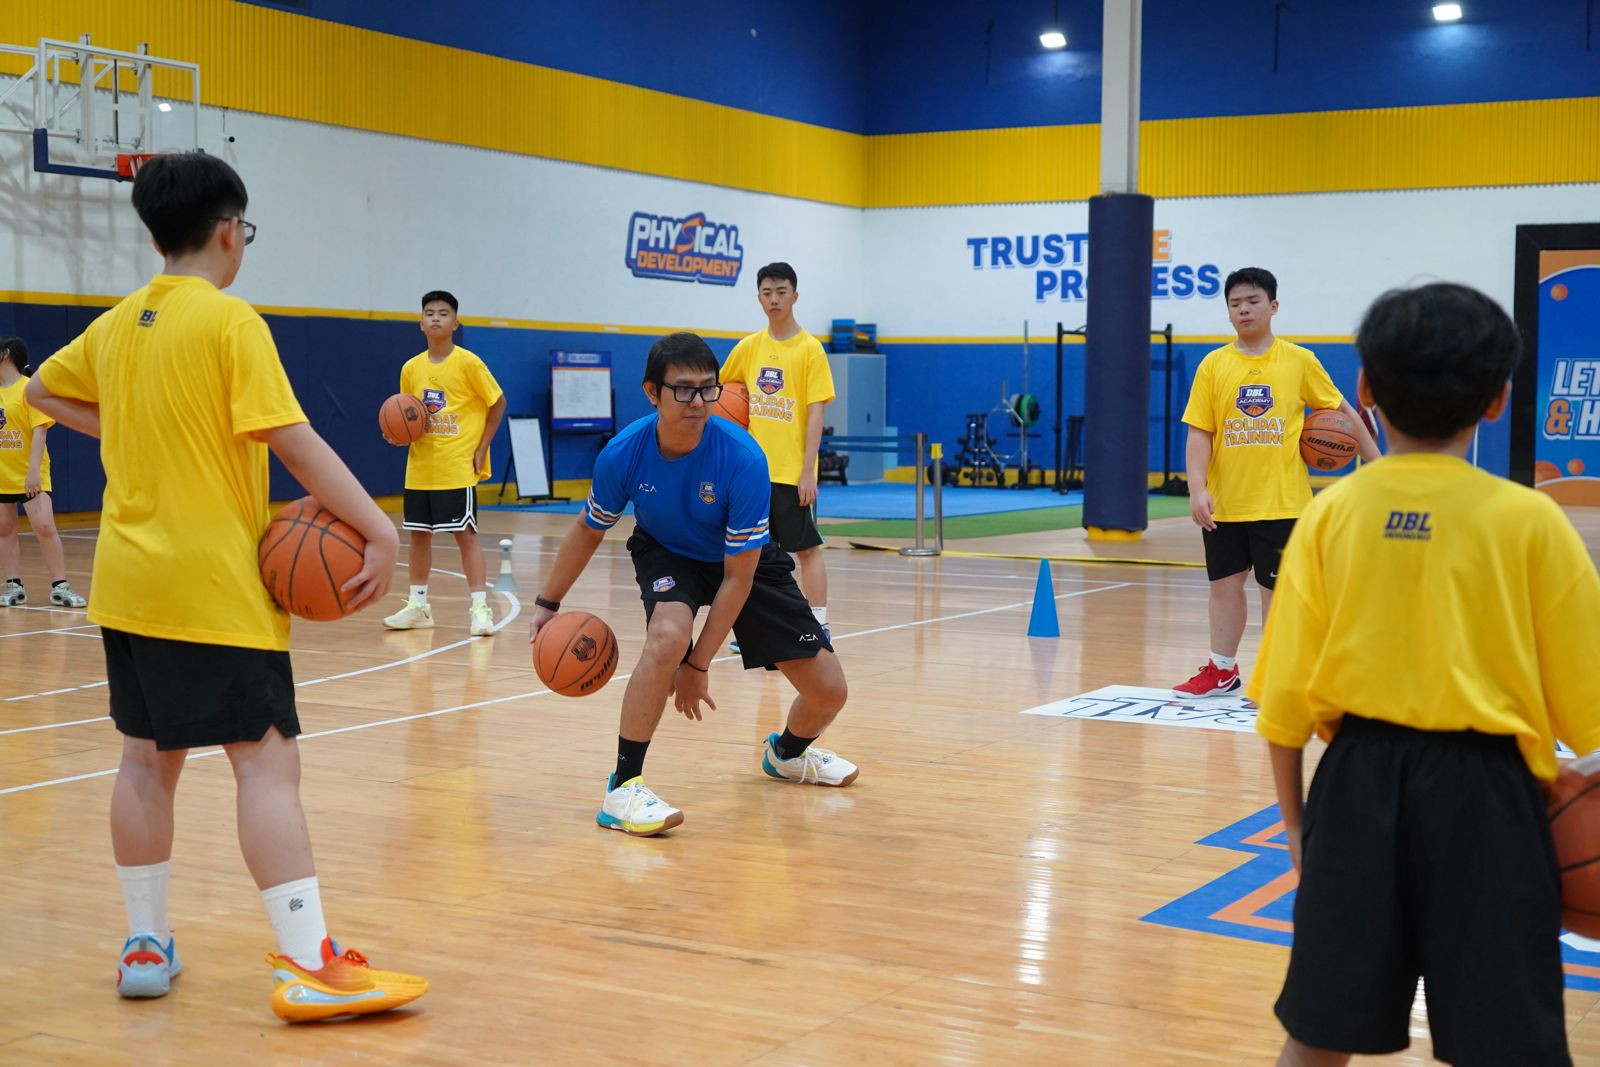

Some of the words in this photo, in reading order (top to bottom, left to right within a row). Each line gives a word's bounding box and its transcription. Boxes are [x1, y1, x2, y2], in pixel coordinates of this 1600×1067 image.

[630, 216, 741, 259] PHYSICAL
[967, 232, 1088, 266] TRUST
[636, 250, 740, 277] DEVELOPMENT
[1036, 265, 1220, 300] PRESS
[749, 393, 796, 410] OLIDAY
[1224, 417, 1286, 433] HOLIDAY
[1545, 398, 1572, 436] &
[1577, 399, 1600, 436] H
[1385, 510, 1432, 531] DBL
